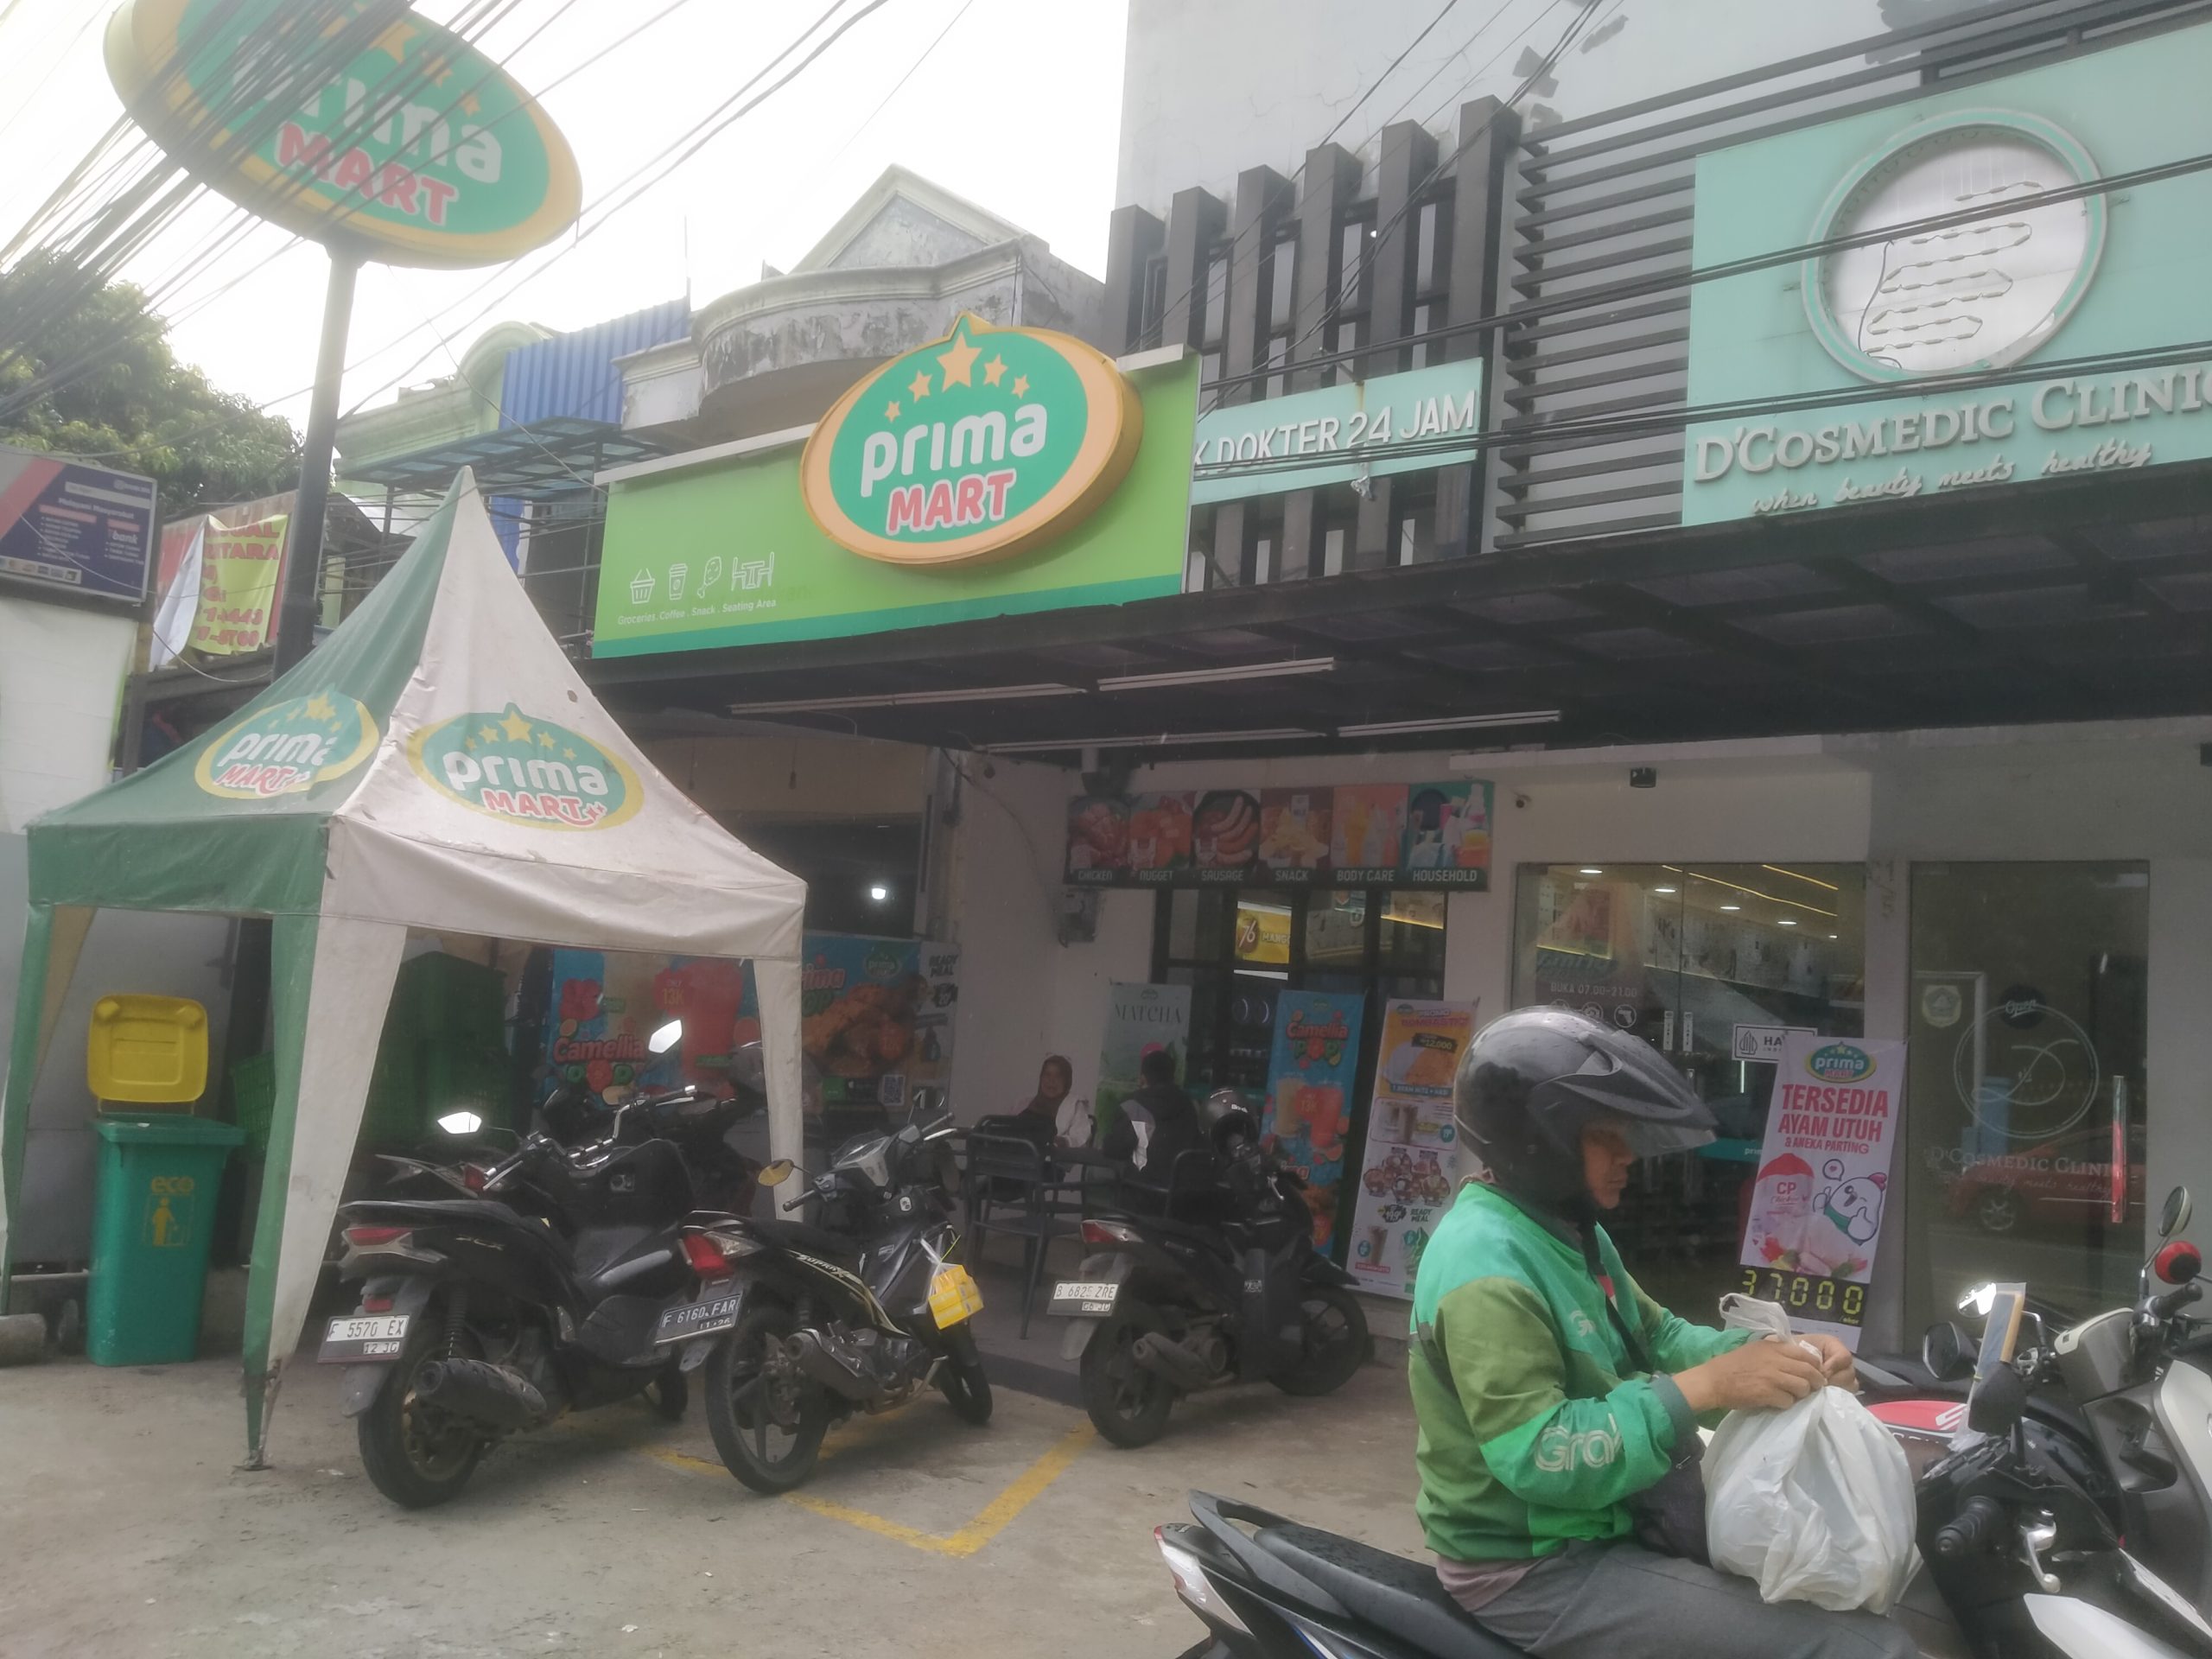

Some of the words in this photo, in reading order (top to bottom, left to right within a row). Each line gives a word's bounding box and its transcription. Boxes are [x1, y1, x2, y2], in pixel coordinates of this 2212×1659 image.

[275, 121, 459, 226] MART
[2031, 361, 2212, 432] CLINI
[1217, 416, 1340, 473] DOKTER
[1347, 410, 1392, 451] 24
[1399, 390, 1475, 441] JAM
[861, 403, 1047, 497] prima
[1752, 488, 1818, 514] when
[1834, 467, 1923, 505] beauty
[1938, 454, 2015, 490] meets
[2040, 436, 2153, 475] healthy
[886, 468, 1016, 535] MART
[659, 608, 685, 620] Coffee
[691, 606, 715, 617] Snack
[721, 600, 754, 613] Seating
[755, 598, 777, 609] Area
[214, 764, 292, 793] MART
[442, 750, 609, 797] prima
[481, 789, 584, 826] MART
[1077, 869, 1113, 881] CHICKEN
[1139, 869, 1174, 881] NUGGET
[1201, 869, 1244, 882] SAUSAGE
[1274, 869, 1309, 882] SNACK
[1336, 869, 1365, 882] BODY
[1366, 869, 1395, 882] CARE
[1412, 869, 1478, 883] HOUSEHOLD
[553, 1033, 646, 1064] Camellia
[1815, 1057, 1865, 1070] prima
[1782, 1084, 1889, 1118] TERSEDIA
[1777, 1114, 1829, 1137] AYAM
[1832, 1117, 1883, 1142] UTUH
[1784, 1137, 1793, 1147] &
[1793, 1137, 1823, 1150] ANEKA
[1824, 1141, 1870, 1154] PARTING
[1777, 1181, 1797, 1195] CP
[1741, 1269, 1864, 1315] 37000
[346, 1321, 378, 1338] 5570
[387, 1320, 405, 1337] EX
